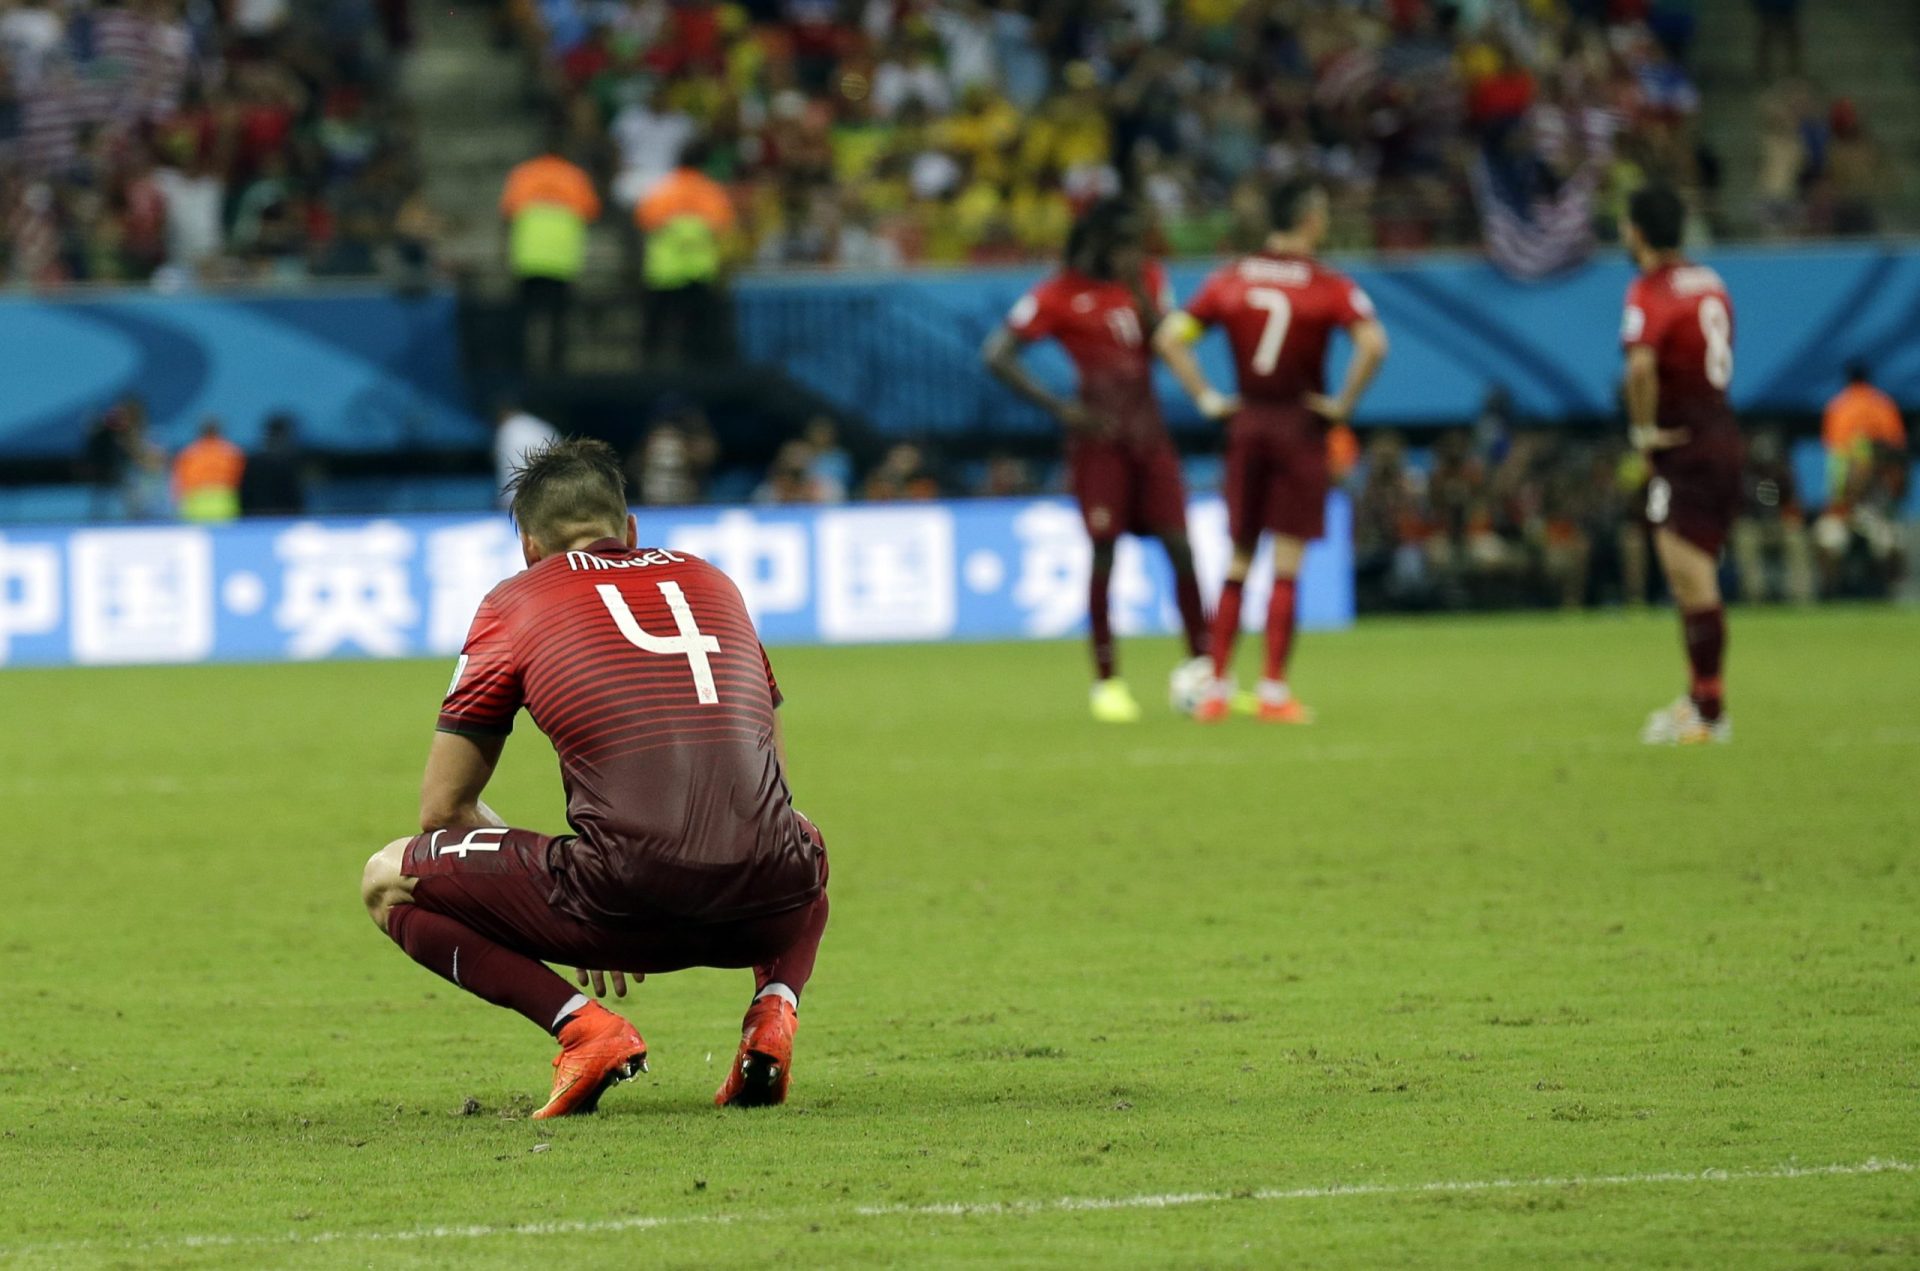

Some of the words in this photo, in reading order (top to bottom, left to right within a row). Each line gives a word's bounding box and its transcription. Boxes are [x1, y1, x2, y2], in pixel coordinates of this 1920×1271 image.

[1247, 287, 1291, 376] 7
[1699, 296, 1733, 390] 8
[594, 580, 722, 704] 4
[440, 828, 510, 858] 4
